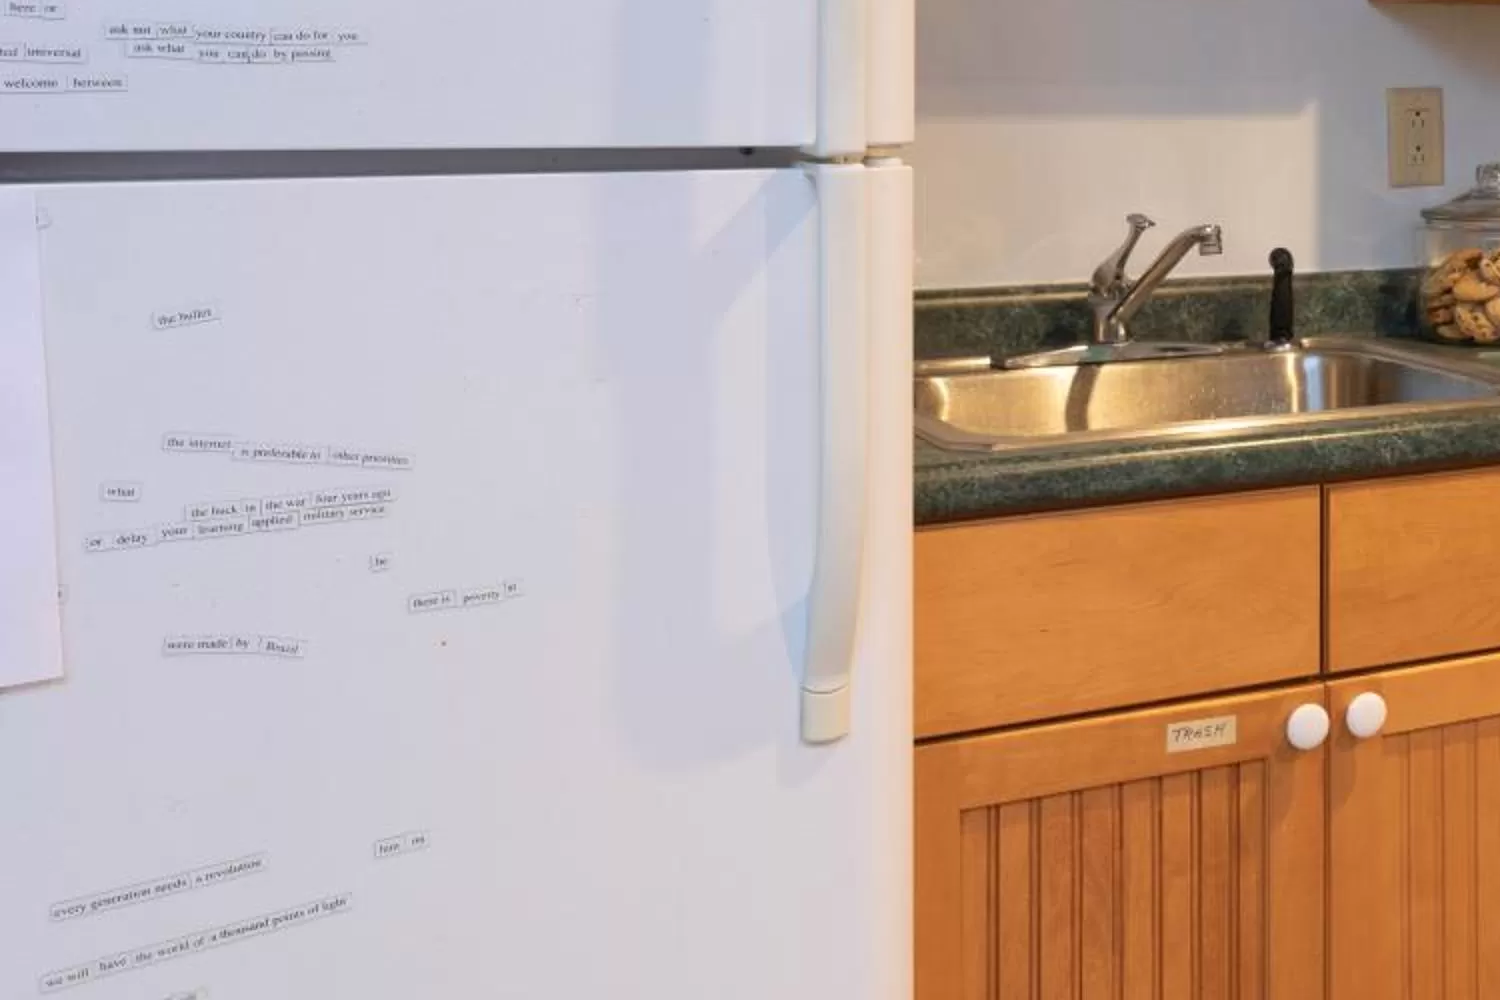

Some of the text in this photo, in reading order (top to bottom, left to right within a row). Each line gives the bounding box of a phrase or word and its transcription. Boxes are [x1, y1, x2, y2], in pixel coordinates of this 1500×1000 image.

[158, 22, 188, 35] what
[196, 29, 220, 41] your
[223, 27, 267, 42] country
[295, 27, 310, 41] do
[337, 31, 359, 42] you
[156, 41, 185, 54] what
[3, 74, 123, 90] welcome between
[167, 435, 185, 448] the
[191, 505, 209, 519] the
[341, 489, 369, 504] years
[116, 531, 149, 547] delay
[161, 525, 189, 538] your
[303, 507, 345, 523] military
[349, 503, 386, 518] service
[463, 591, 501, 607] poverty
[198, 636, 229, 649] made
[1171, 722, 1227, 743] TRASH
[54, 899, 88, 919] every
[91, 886, 151, 912] generation
[155, 876, 189, 898] needs
[205, 857, 263, 883] revolution
[67, 965, 90, 983] will
[99, 954, 128, 973] have
[135, 950, 155, 966] the
[157, 940, 191, 961] world
[218, 916, 270, 941] thousand
[271, 906, 306, 930] points
[321, 896, 349, 911] light
